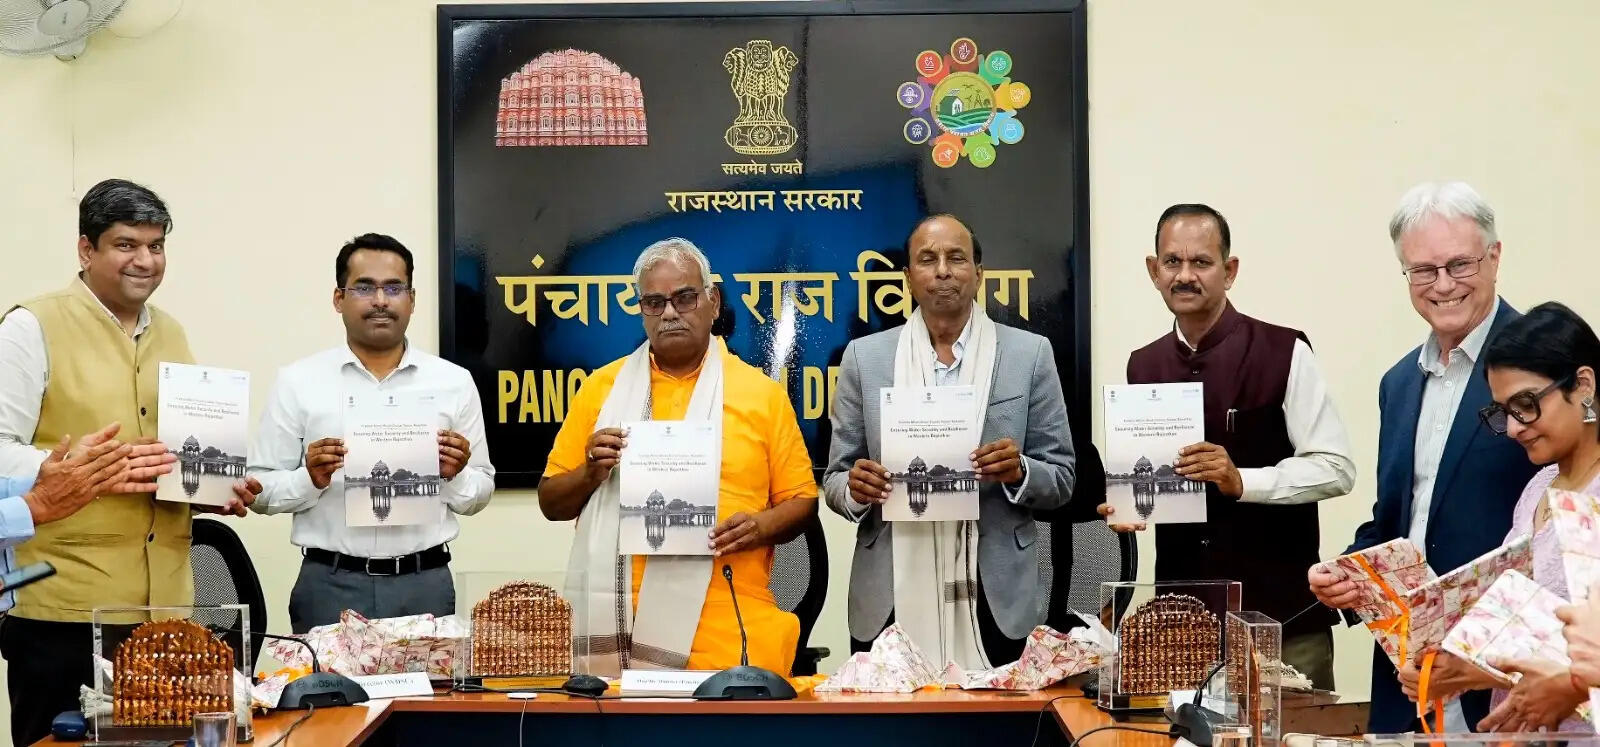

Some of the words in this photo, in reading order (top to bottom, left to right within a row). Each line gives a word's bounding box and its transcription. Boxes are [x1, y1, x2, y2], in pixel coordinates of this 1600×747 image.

[721, 160, 767, 175] सत्यमेव
[770, 159, 803, 175] जयते
[664, 190, 776, 213] राजस्थान
[780, 190, 863, 212] सरकार
[733, 272, 840, 325] राज
